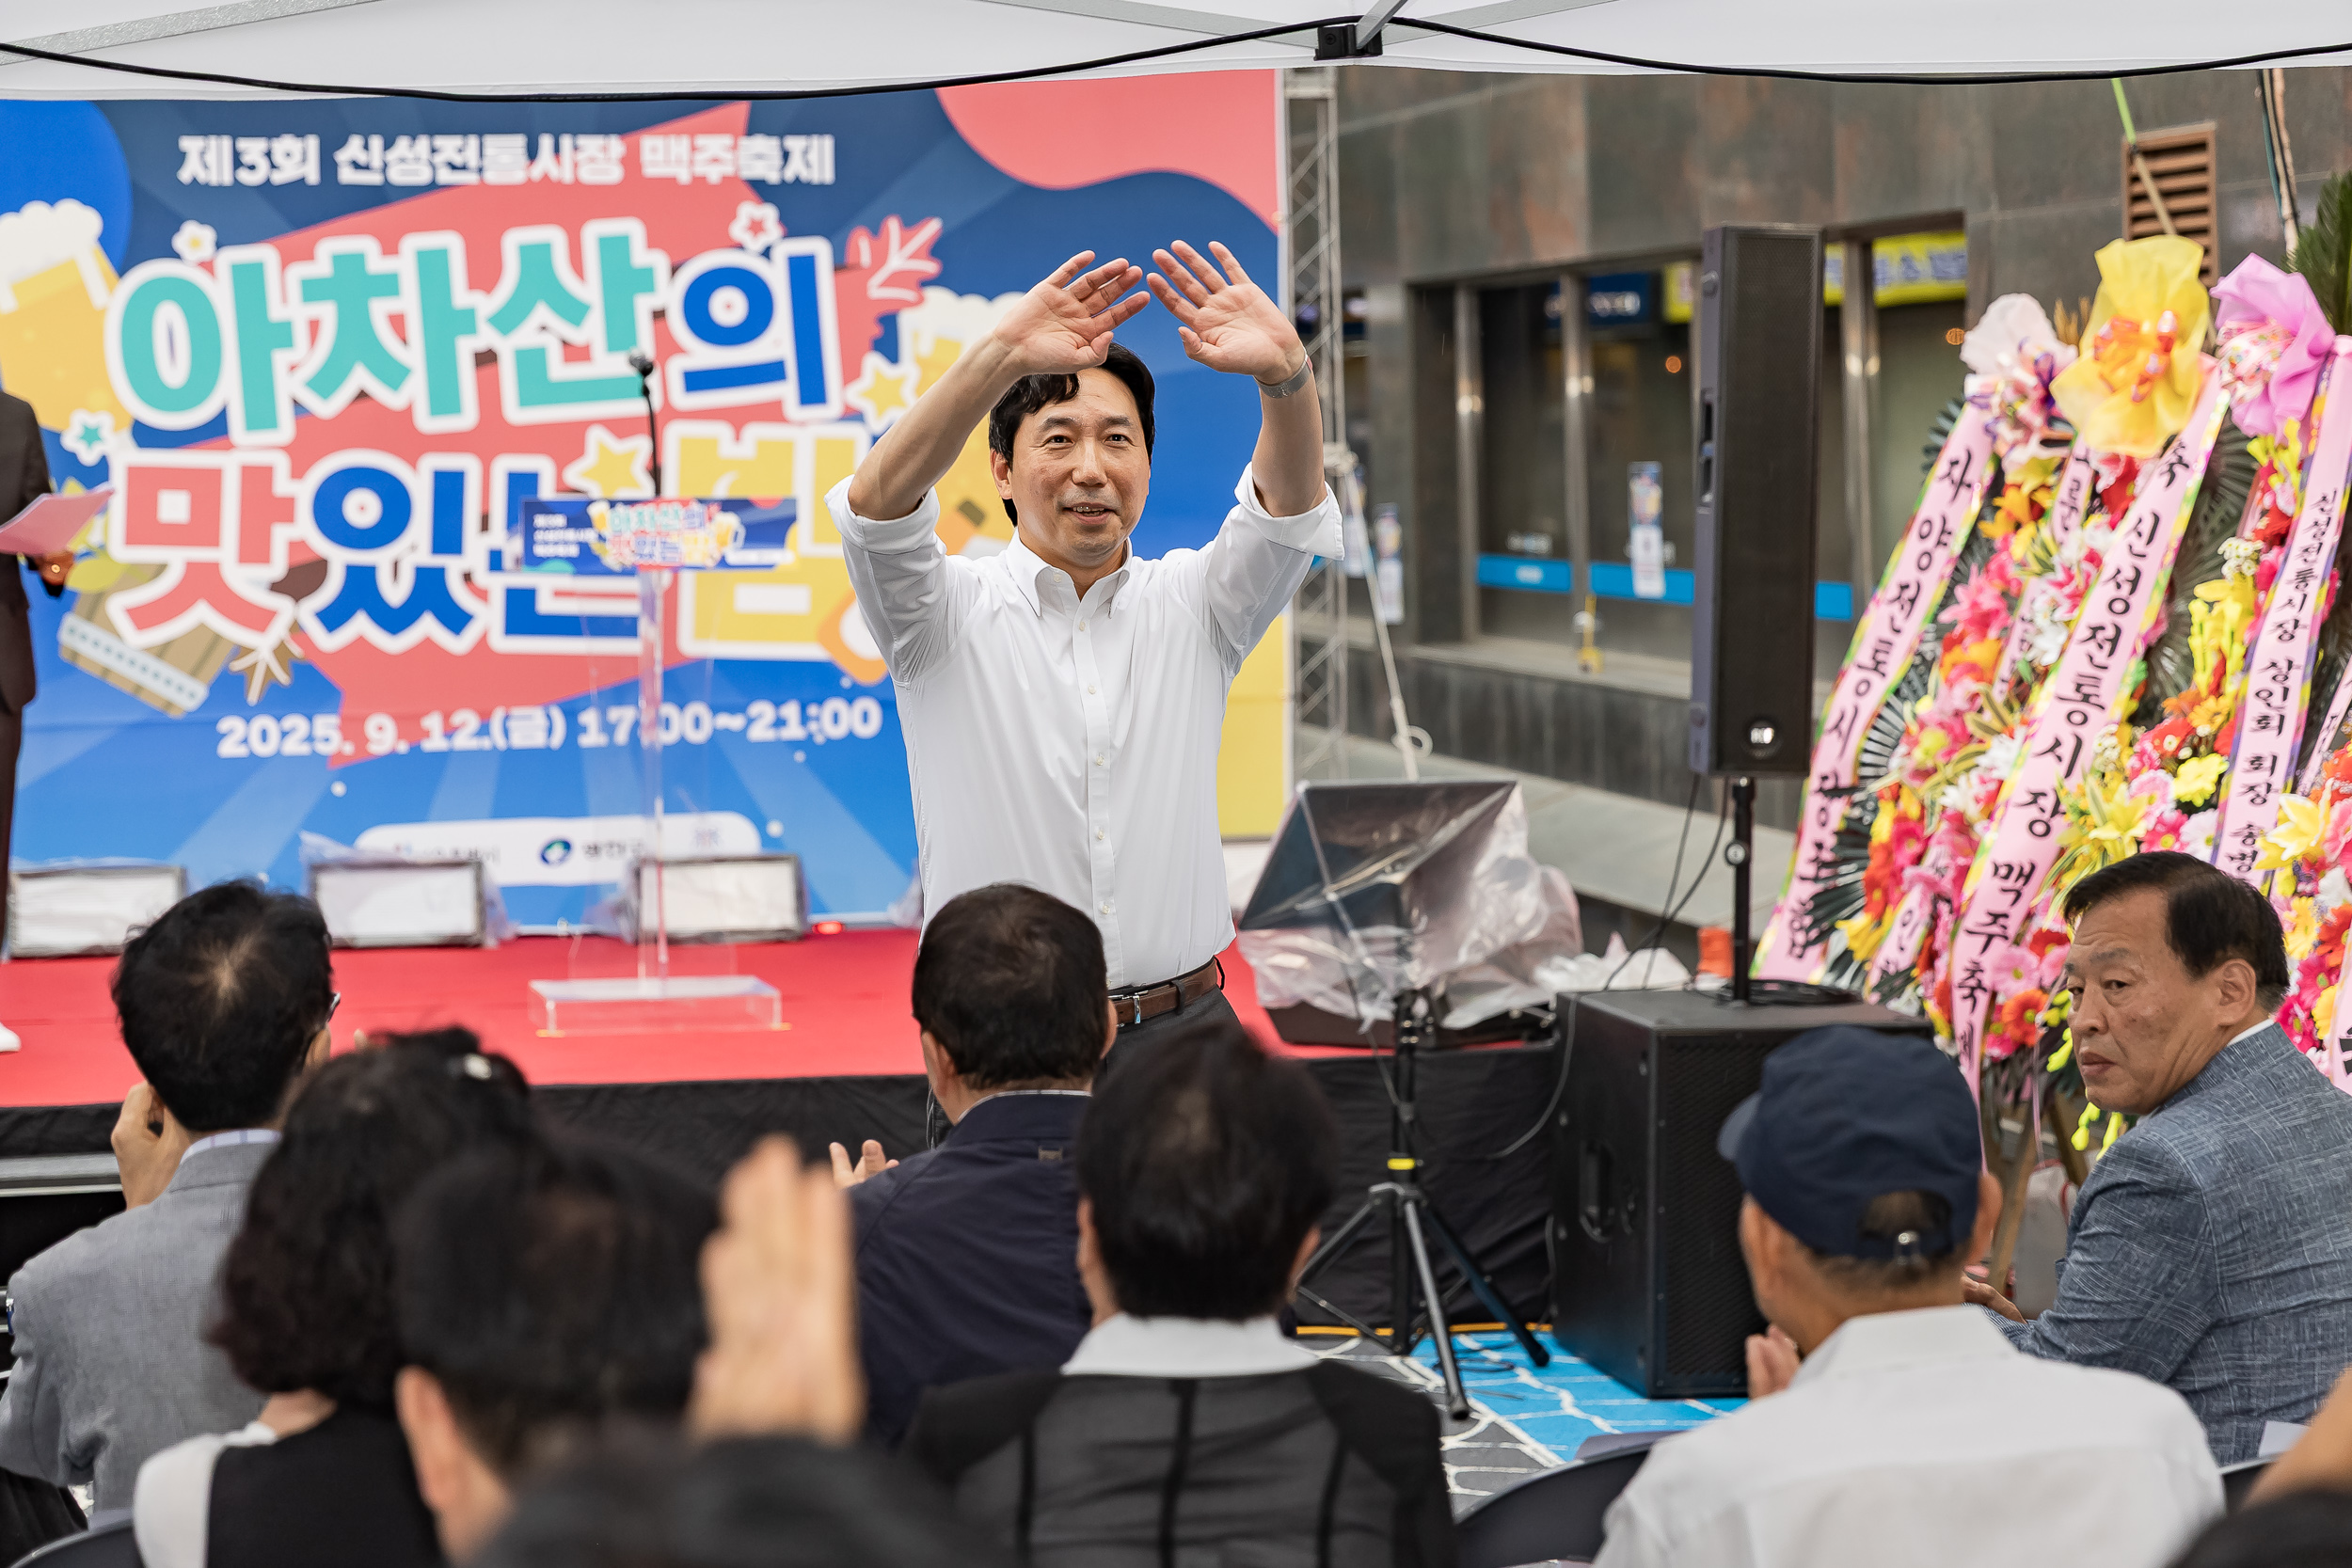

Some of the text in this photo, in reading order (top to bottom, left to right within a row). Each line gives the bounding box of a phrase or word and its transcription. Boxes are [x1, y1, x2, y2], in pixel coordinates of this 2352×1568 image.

[176, 133, 836, 186] 제3회 신성전통시장 맥주축제
[106, 218, 843, 446] 아차산의
[2158, 439, 2190, 488] 축
[2273, 490, 2337, 643] 신성전통시장
[2014, 513, 2160, 838] 신성전통시장
[2252, 658, 2300, 736] 상인회
[215, 713, 355, 758] 2025.
[363, 712, 410, 755] 9.
[2243, 754, 2279, 806] 회장
